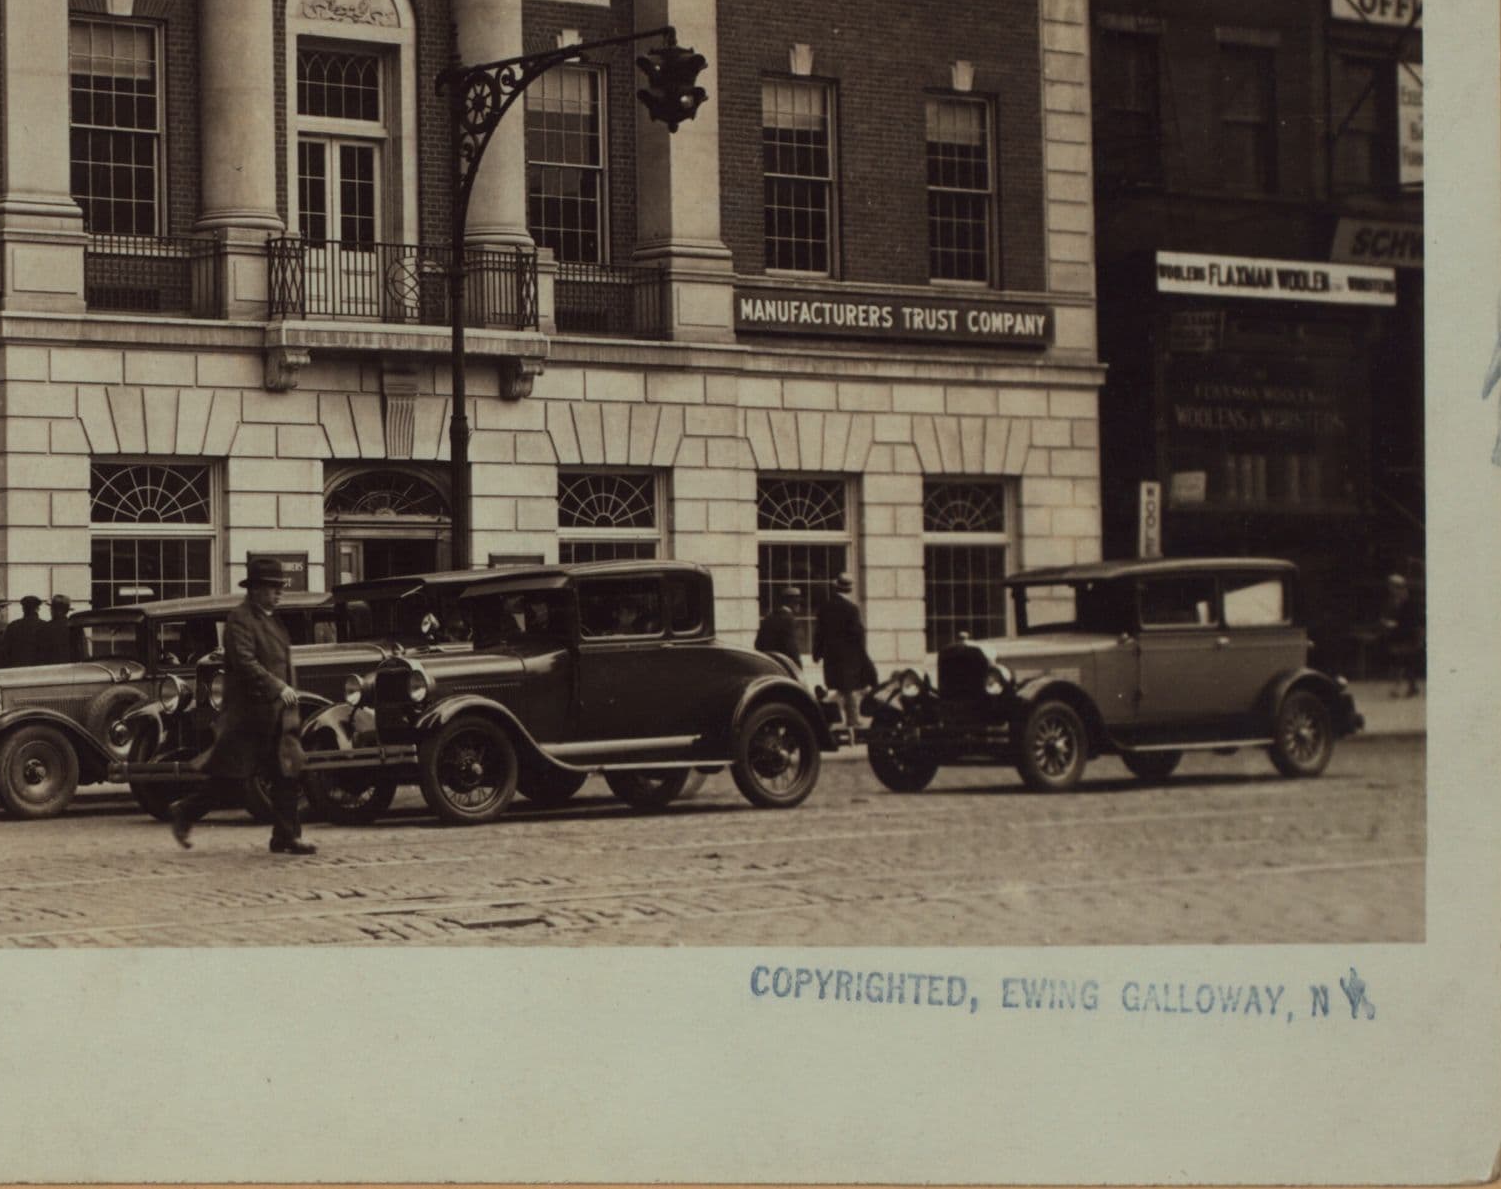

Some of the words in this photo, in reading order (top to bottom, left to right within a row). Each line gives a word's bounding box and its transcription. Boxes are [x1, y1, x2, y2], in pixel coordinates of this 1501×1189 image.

[740, 298, 894, 329] MANUFACTURERS
[902, 306, 960, 331] TRUST
[966, 311, 1046, 336] COMPANY
